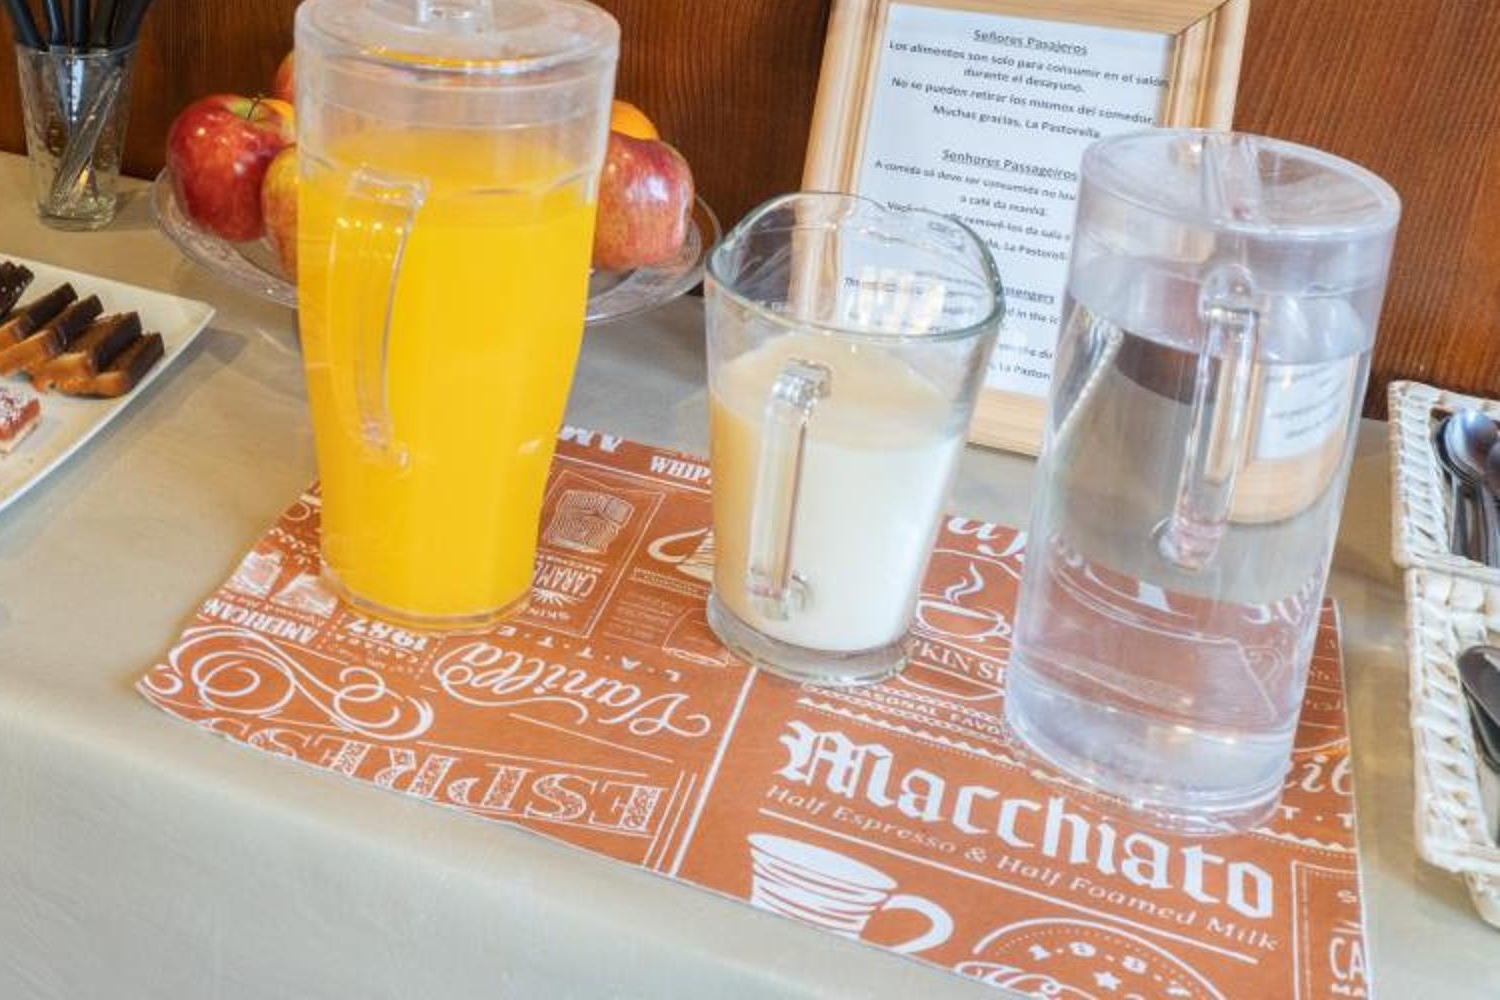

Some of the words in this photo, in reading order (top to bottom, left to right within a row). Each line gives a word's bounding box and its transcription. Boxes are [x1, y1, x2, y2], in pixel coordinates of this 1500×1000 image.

[889, 39, 909, 51] Los
[910, 43, 965, 60] alimentos
[967, 51, 989, 63] son
[1017, 59, 1044, 73] para
[1045, 61, 1101, 79] consumir
[1103, 71, 1119, 81] en
[1121, 72, 1133, 84] el
[973, 28, 1023, 47] Señores
[1027, 36, 1088, 57] Pasajeros
[891, 76, 908, 89] No
[910, 81, 923, 91] se
[925, 82, 967, 98] pueden
[1009, 93, 1027, 106] los
[1029, 97, 1074, 114] mismos
[1077, 103, 1096, 116] del
[963, 67, 1009, 83] durante
[1011, 73, 1023, 85] el
[932, 105, 977, 121] Muchas
[1025, 118, 1038, 130] La
[1041, 120, 1100, 139] Pastorella
[937, 170, 963, 183] deve
[942, 149, 1001, 169] Senhores
[1003, 159, 1077, 181] Passageiros
[201, 598, 319, 645] AMERICAN
[432, 641, 711, 737] Vanilla
[773, 720, 1273, 919] Macchiato
[766, 784, 828, 816] Half
[832, 805, 957, 856] Espresso
[963, 847, 988, 864] &
[996, 854, 1061, 886] Half
[1069, 876, 1197, 926] Foamed
[1206, 917, 1279, 951] Milk
